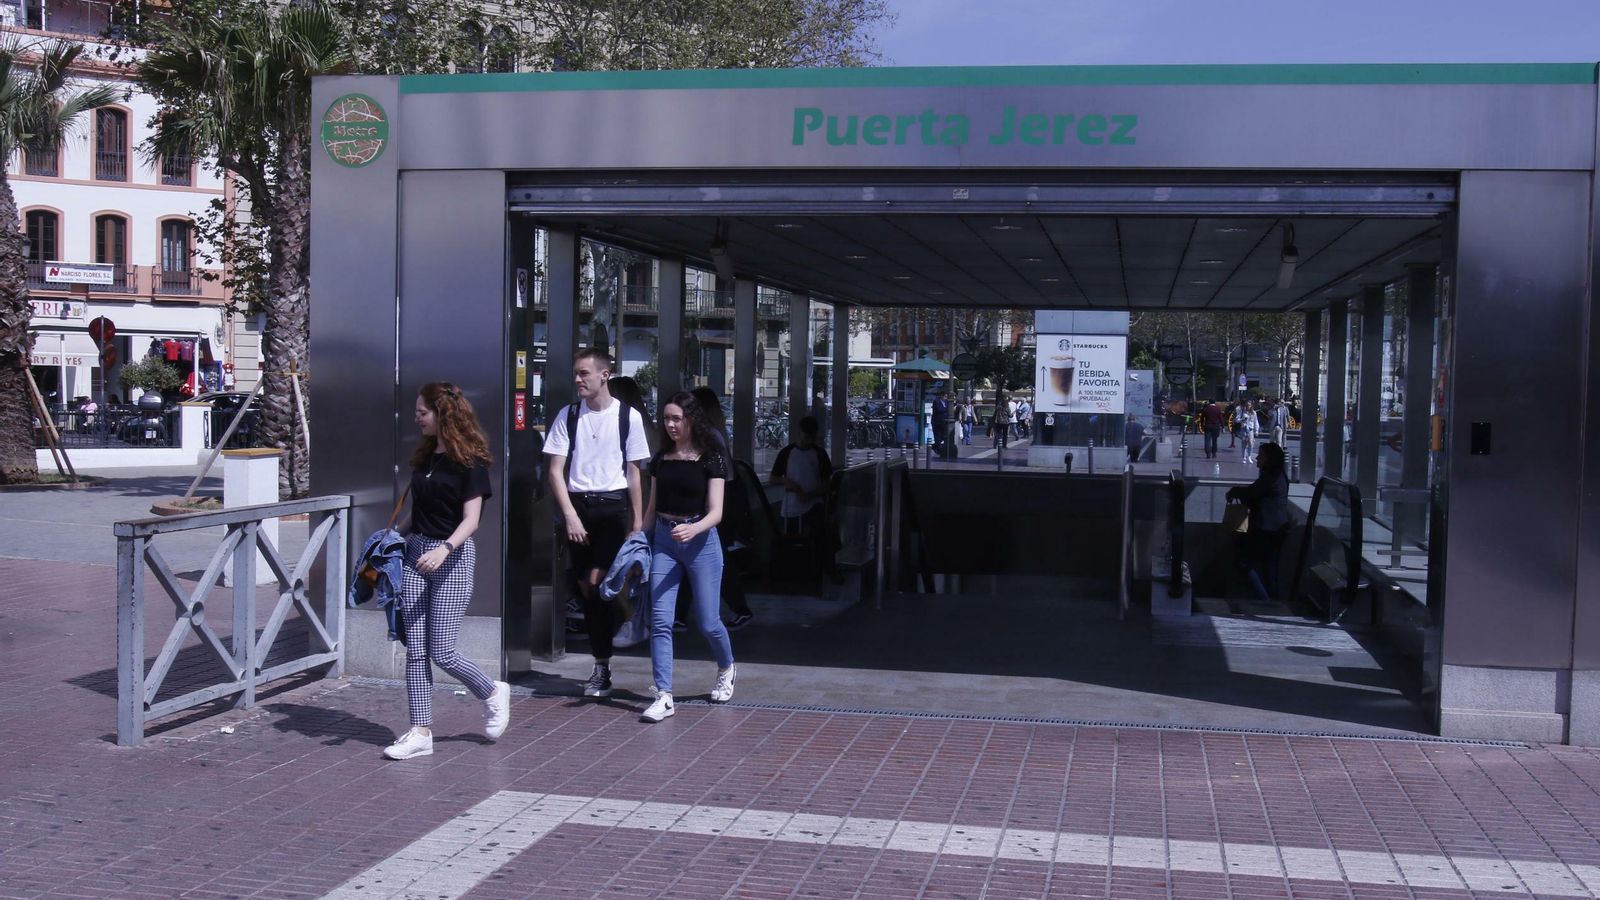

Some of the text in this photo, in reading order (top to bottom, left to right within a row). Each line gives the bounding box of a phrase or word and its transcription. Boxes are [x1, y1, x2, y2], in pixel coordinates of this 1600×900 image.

[792, 105, 1139, 146] Puerta Jerez
[52, 356, 82, 366] RYES
[1079, 361, 1090, 369] TU
[1079, 370, 1110, 378] BEBIDA
[1078, 378, 1120, 387] FAVORITA
